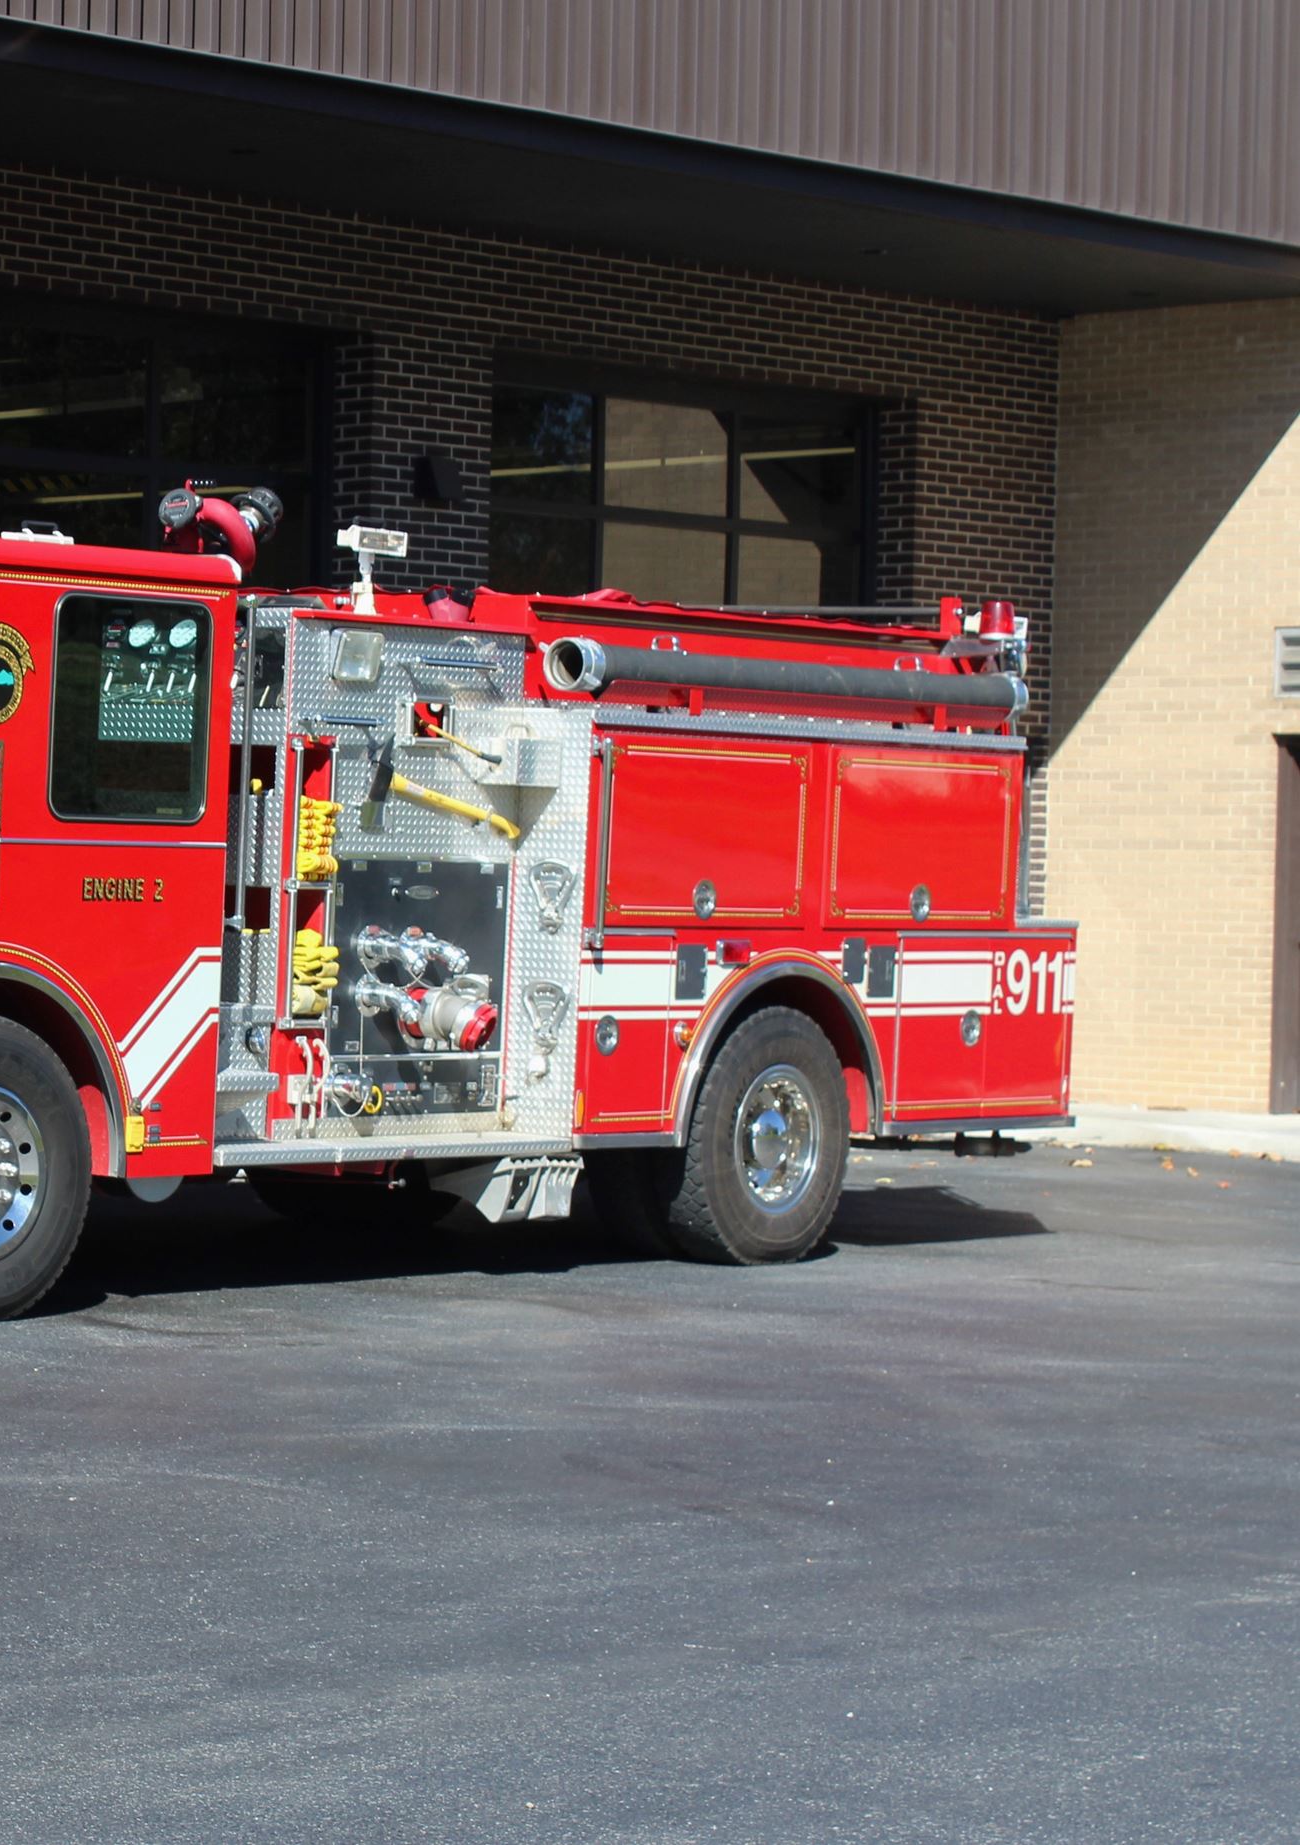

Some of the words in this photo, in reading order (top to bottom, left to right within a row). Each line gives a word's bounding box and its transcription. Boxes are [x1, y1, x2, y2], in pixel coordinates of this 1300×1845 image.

[82, 877, 145, 902] ENGINE
[153, 878, 164, 902] 2
[993, 950, 1006, 1015] DIAL
[1006, 947, 1064, 1016] 911
